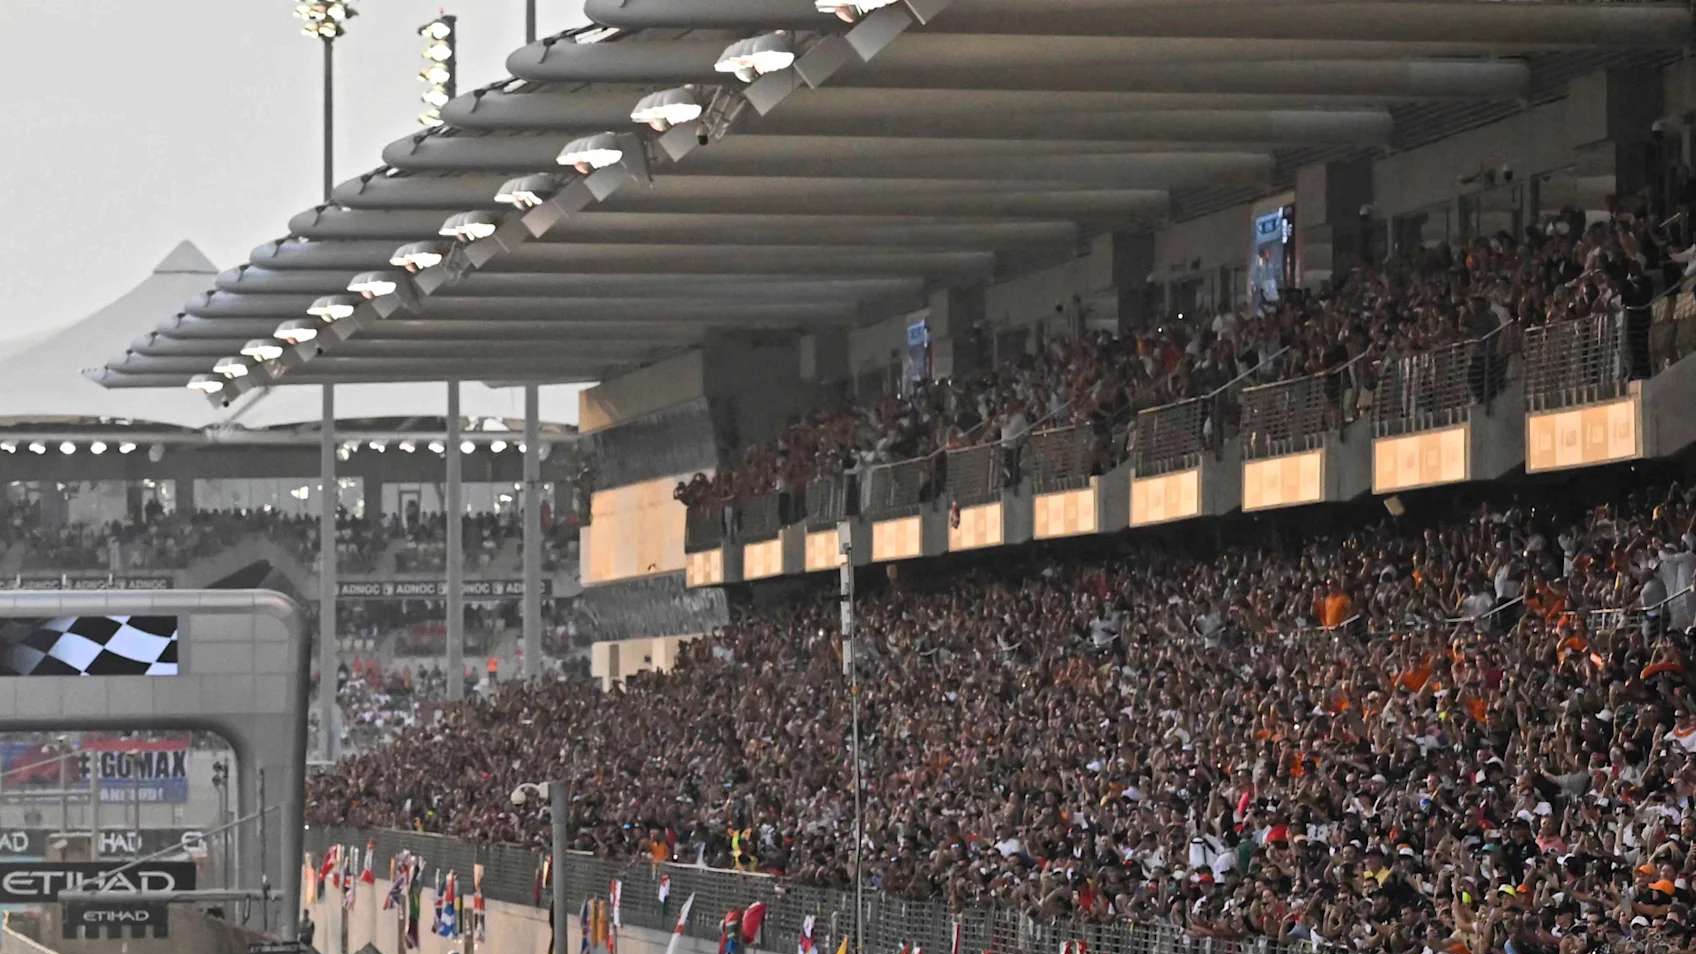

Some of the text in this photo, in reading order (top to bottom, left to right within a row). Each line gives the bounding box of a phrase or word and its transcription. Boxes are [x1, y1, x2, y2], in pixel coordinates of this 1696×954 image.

[395, 584, 435, 594] ADNOC
[2, 871, 175, 895] ETIHAD
[83, 910, 149, 922] ETIHAD
